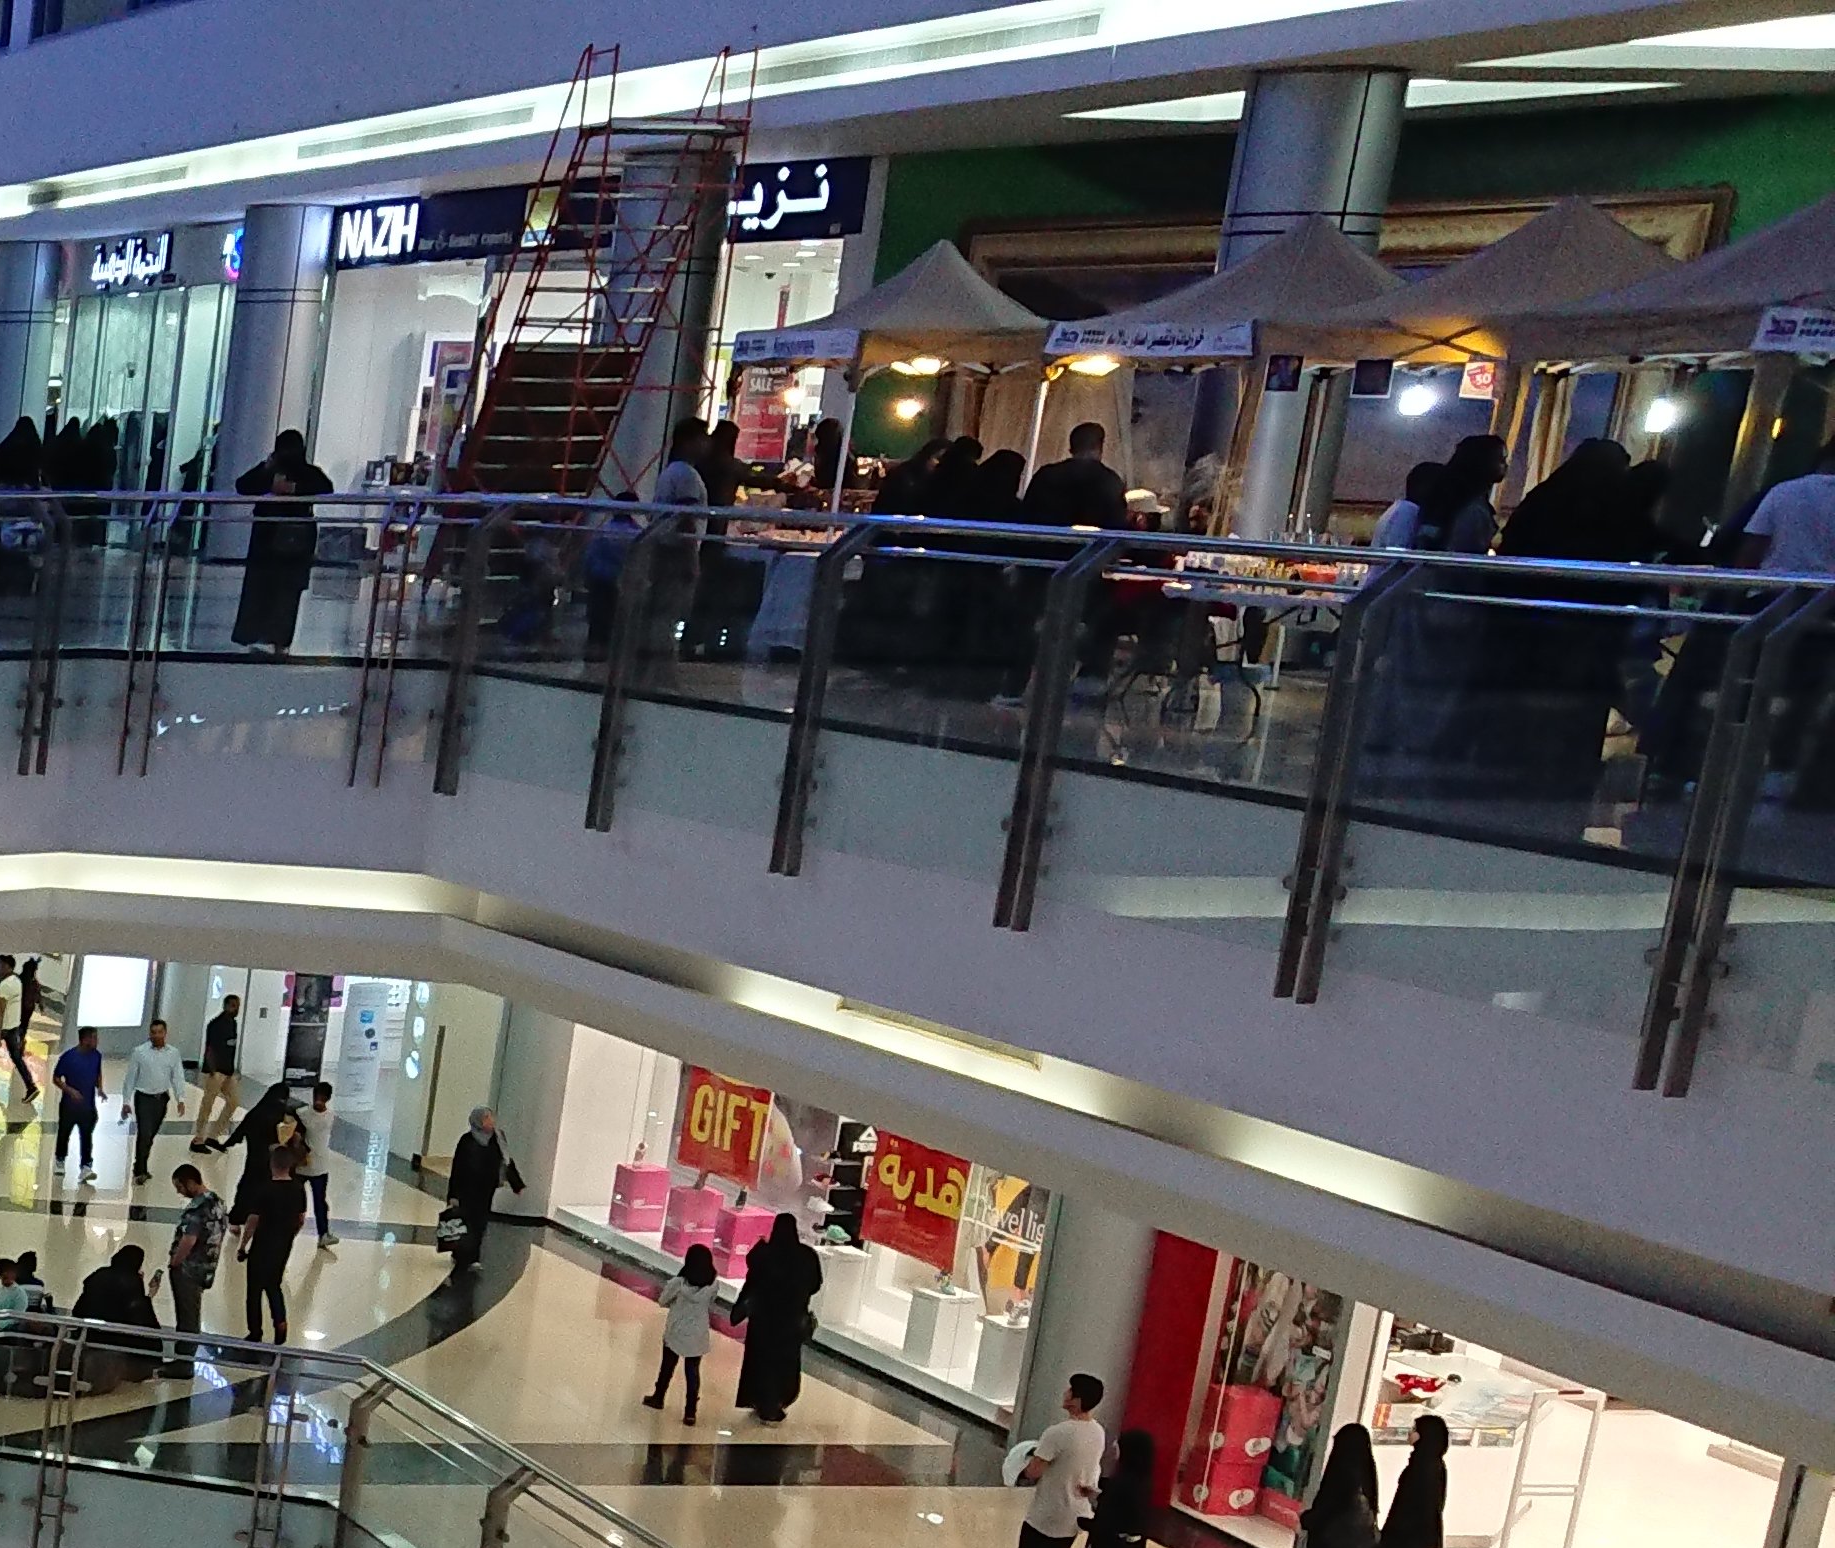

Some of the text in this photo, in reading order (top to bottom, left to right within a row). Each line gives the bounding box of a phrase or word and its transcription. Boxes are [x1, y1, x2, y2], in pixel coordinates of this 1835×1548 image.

[727, 163, 830, 230] نزي
[338, 202, 420, 260] NAZIH
[748, 377, 773, 392] SALE
[689, 1084, 770, 1161] GIFT
[878, 1139, 966, 1220] هدية
